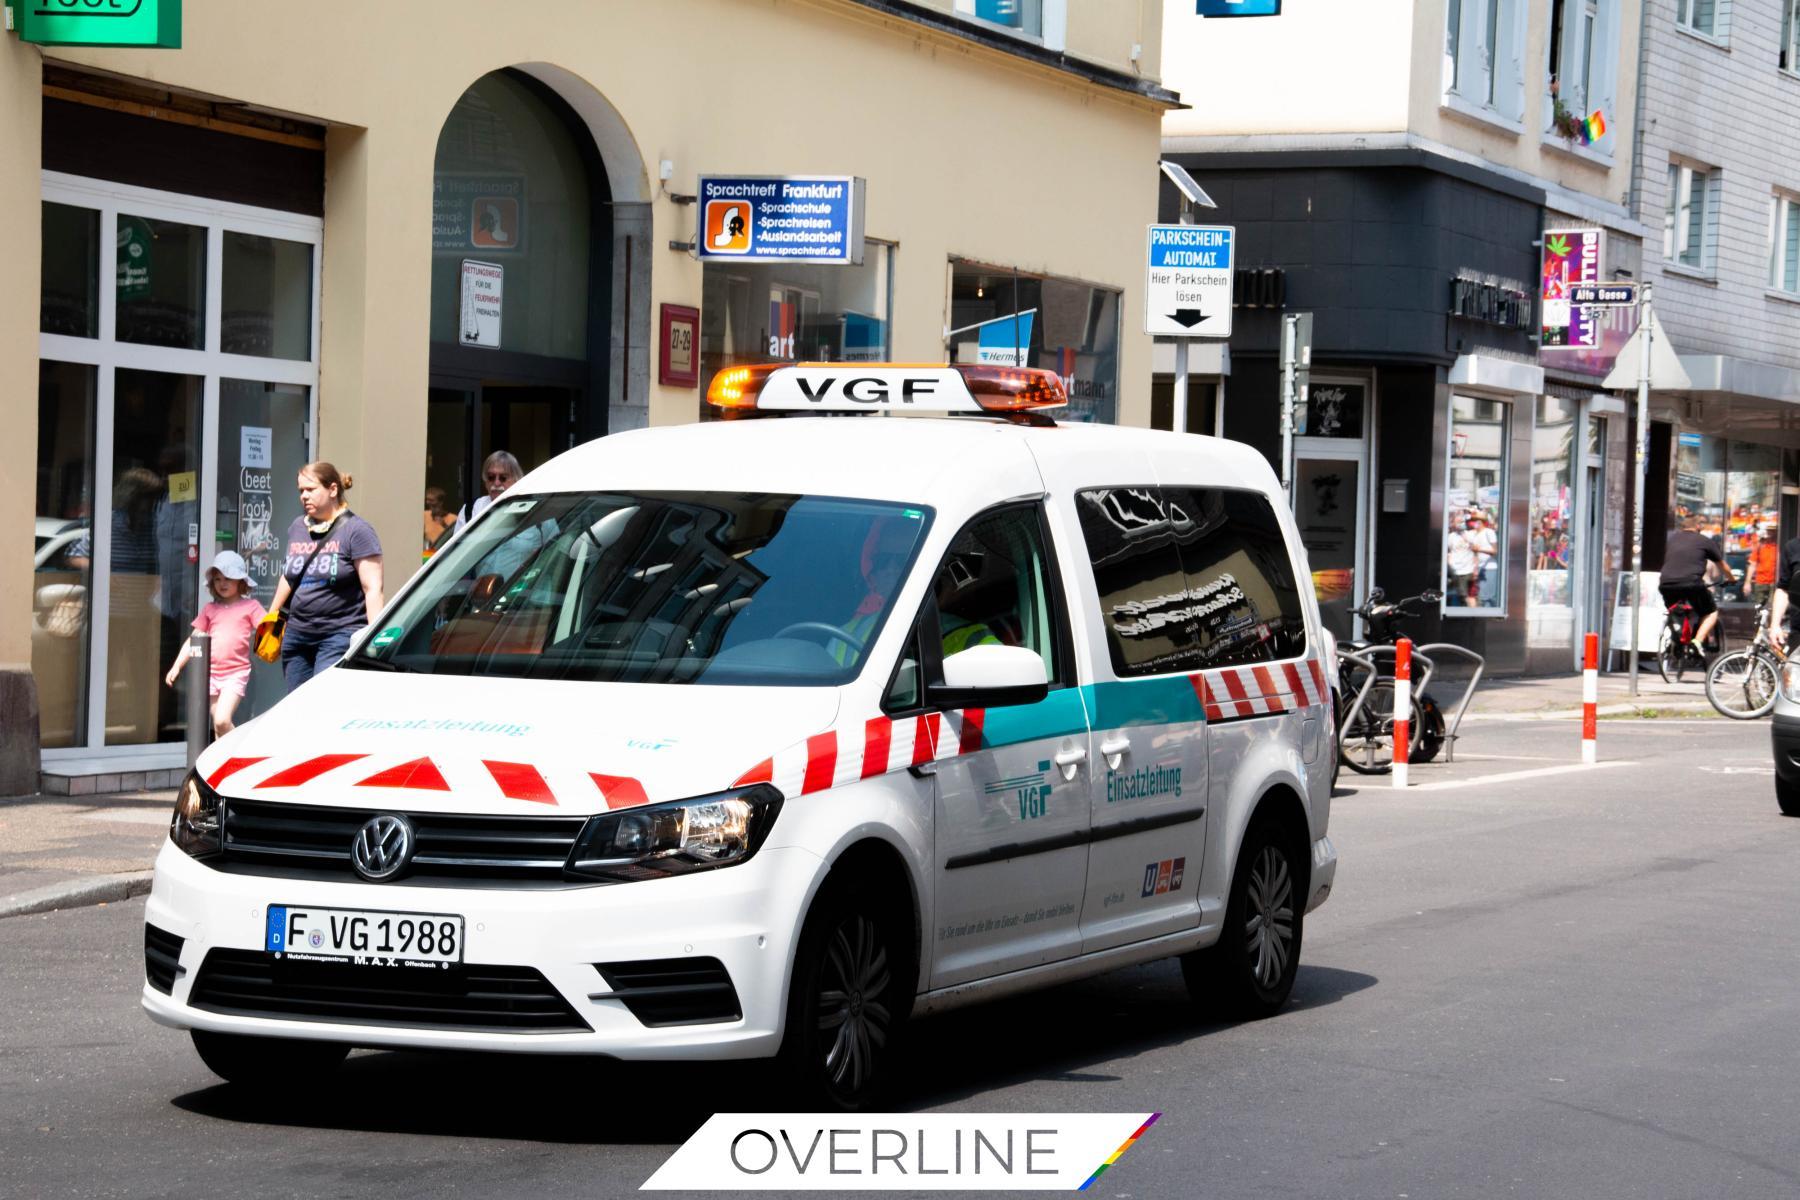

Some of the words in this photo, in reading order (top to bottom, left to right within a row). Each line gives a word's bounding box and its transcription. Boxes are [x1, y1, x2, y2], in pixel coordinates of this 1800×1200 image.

[706, 182, 776, 197] Sprachtreff
[782, 184, 842, 198] Frankfurt
[758, 202, 832, 215] -Sprachschule
[757, 216, 832, 229] -Sprachreisen
[757, 231, 842, 243] -Auslandsarbeit
[1152, 230, 1230, 247] PARKSCHEIN-
[756, 246, 841, 256] www.sprachtreff.de
[1163, 251, 1217, 266] AUTOMAT
[1152, 273, 1171, 284] Hier
[1175, 273, 1228, 287] Parkschein
[1176, 290, 1202, 302] lösen
[1575, 290, 1596, 301] Alte
[1598, 289, 1627, 301] Gasse
[671, 327, 691, 351] 27-29
[795, 377, 940, 404] VGF
[241, 467, 271, 493] (beet
[242, 496, 272, 520] root)
[340, 718, 532, 737] Einsatzleitung
[626, 737, 678, 750] VGF
[1106, 765, 1182, 803] Einsatzleitung
[273, 934, 281, 943] D
[288, 913, 308, 946] F
[330, 915, 369, 951] VG
[376, 919, 456, 956] 1988
[287, 953, 349, 963] Nutzfahrzeugzentrum
[404, 961, 436, 969] Offenbach
